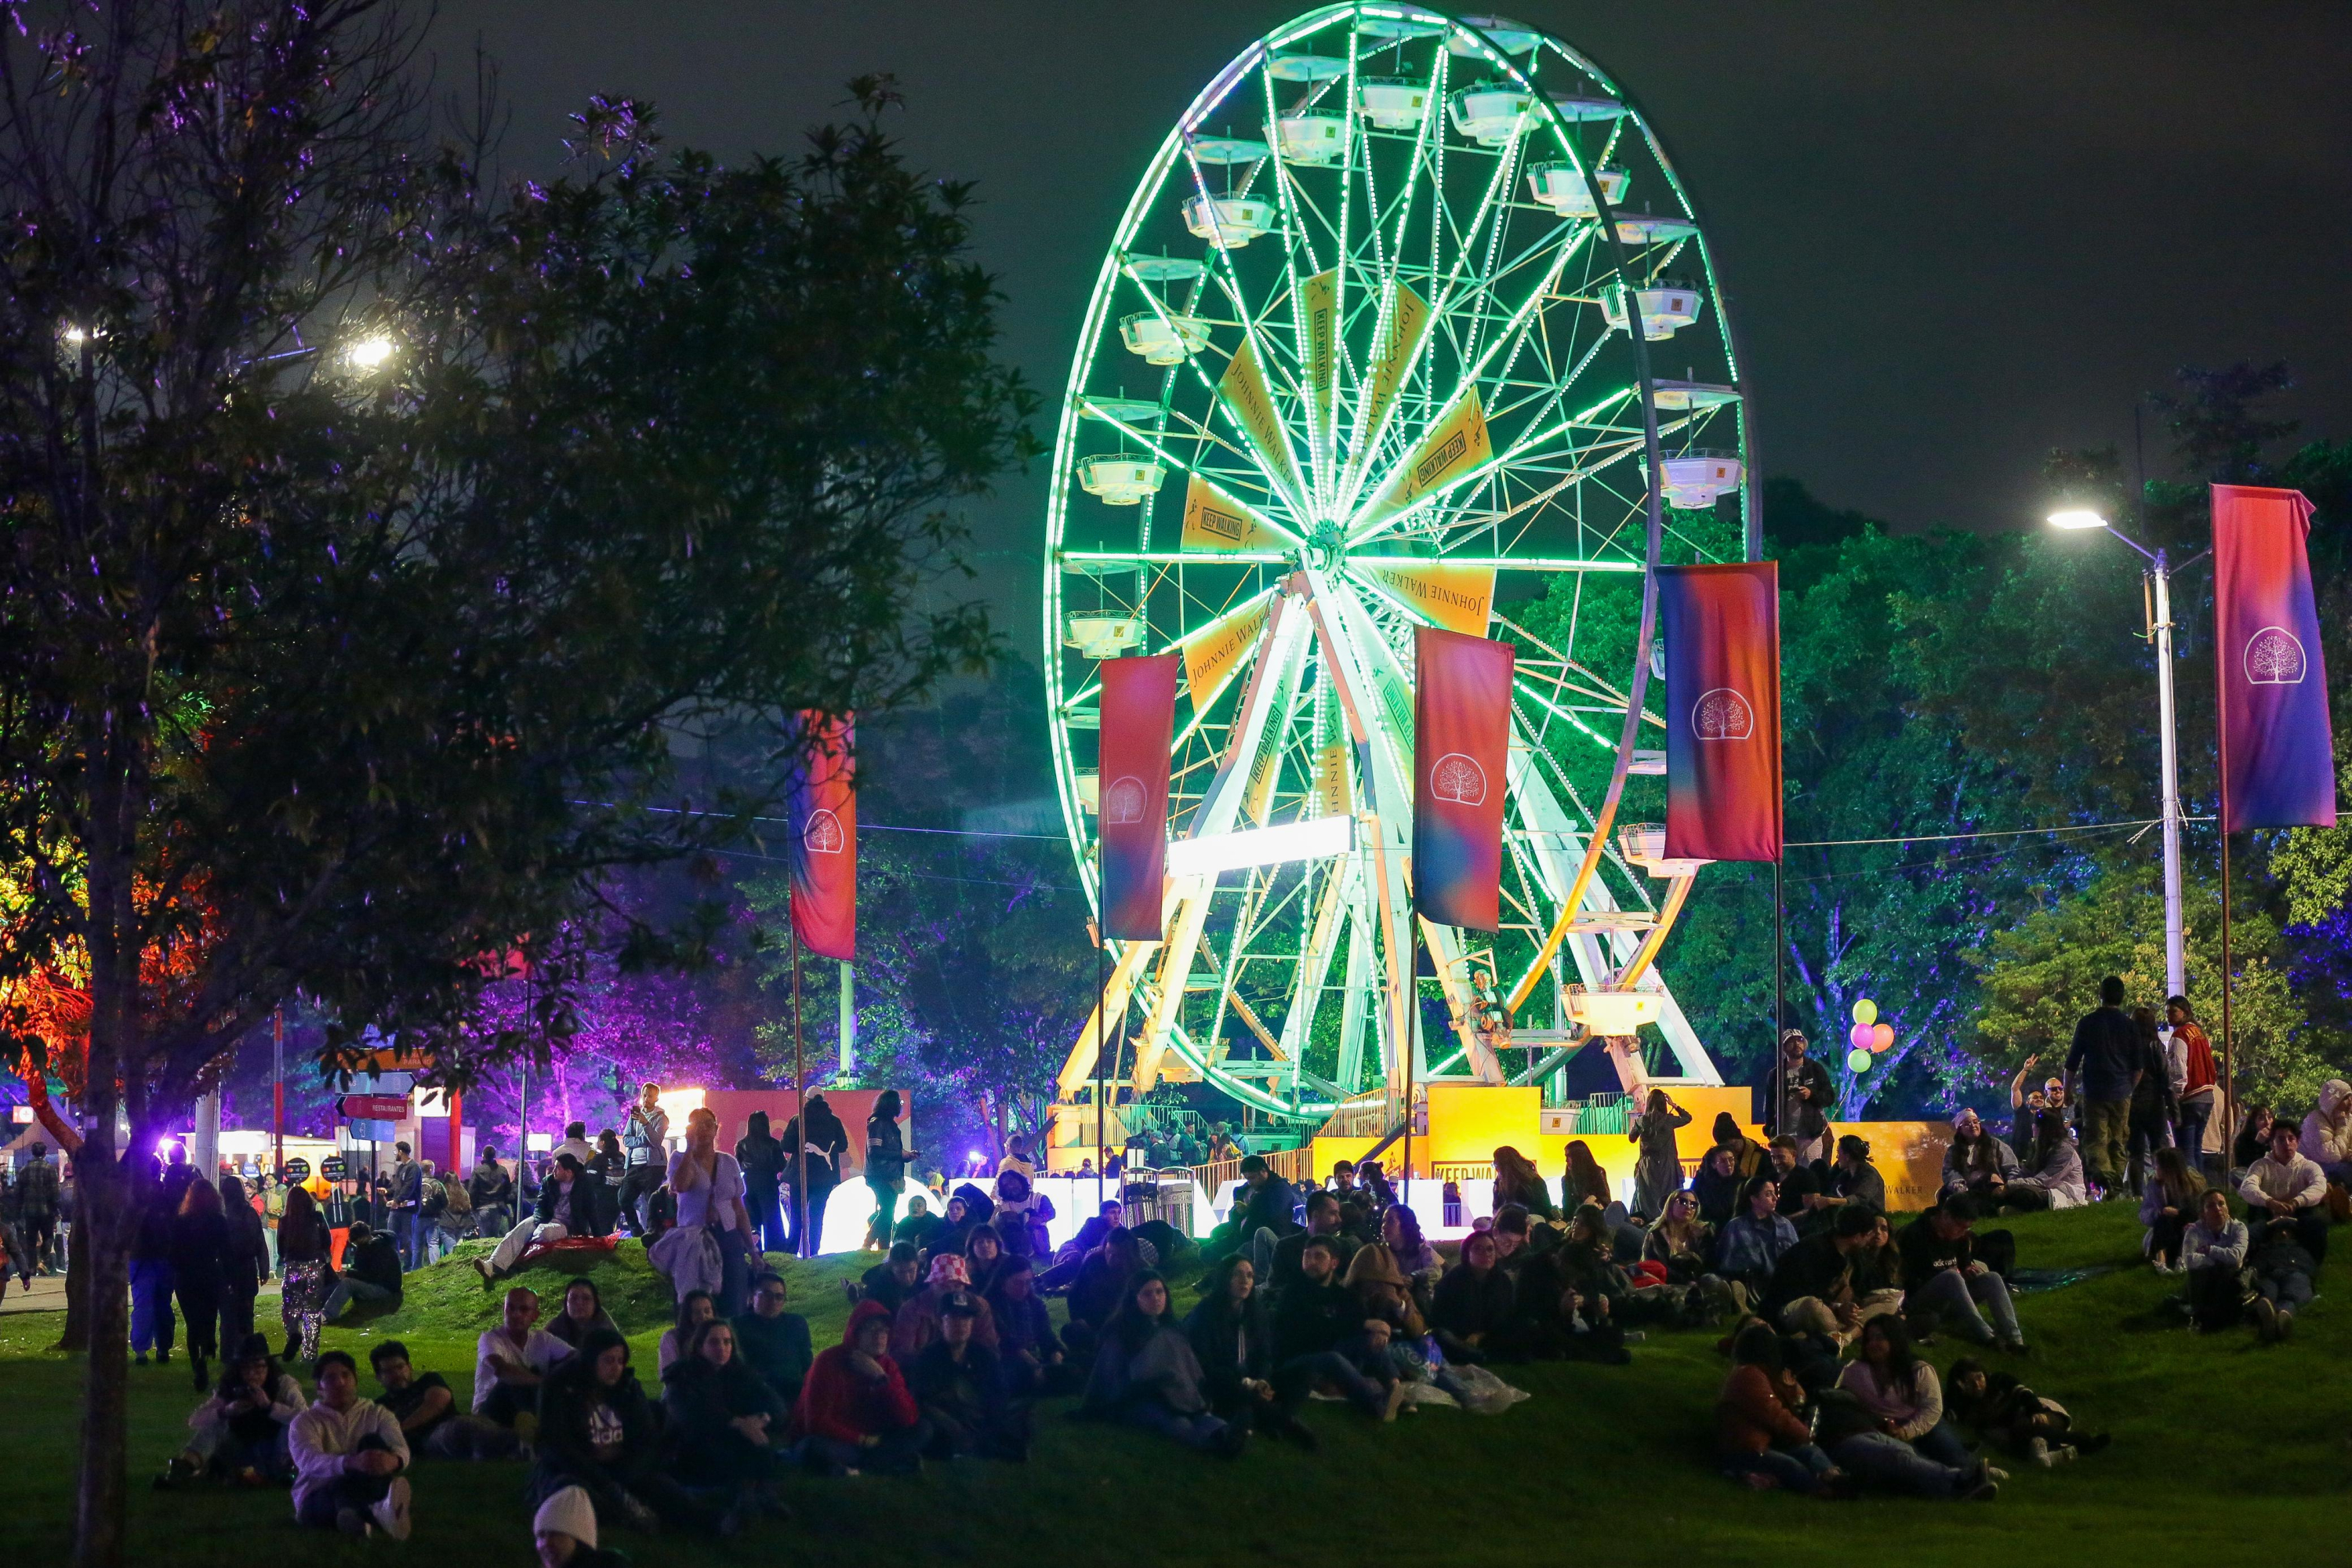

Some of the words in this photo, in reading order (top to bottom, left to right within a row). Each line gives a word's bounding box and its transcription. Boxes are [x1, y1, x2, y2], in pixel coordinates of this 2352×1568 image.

[1317, 312, 1326, 339] KEEP
[1383, 298, 1414, 386] JOHNNIE
[1318, 340, 1327, 388] WALKING
[1231, 364, 1265, 430] JOHNNIE
[1264, 425, 1295, 490] WALKER
[1448, 436, 1464, 459] KEEP
[1420, 448, 1448, 481] WALKING
[1203, 511, 1216, 528] KEEP
[1216, 516, 1240, 536] WALKING
[1383, 569, 1427, 598] WALKER
[1431, 585, 1485, 615] JOHNNIE
[1192, 638, 1235, 687] JOHNNIE
[1386, 683, 1408, 728] WALKING
[1253, 753, 1265, 780] KEEP
[1261, 710, 1279, 751] WALKING
[372, 1104, 405, 1112] RESTAURANTES
[1885, 1185, 1922, 1194] WALKER
